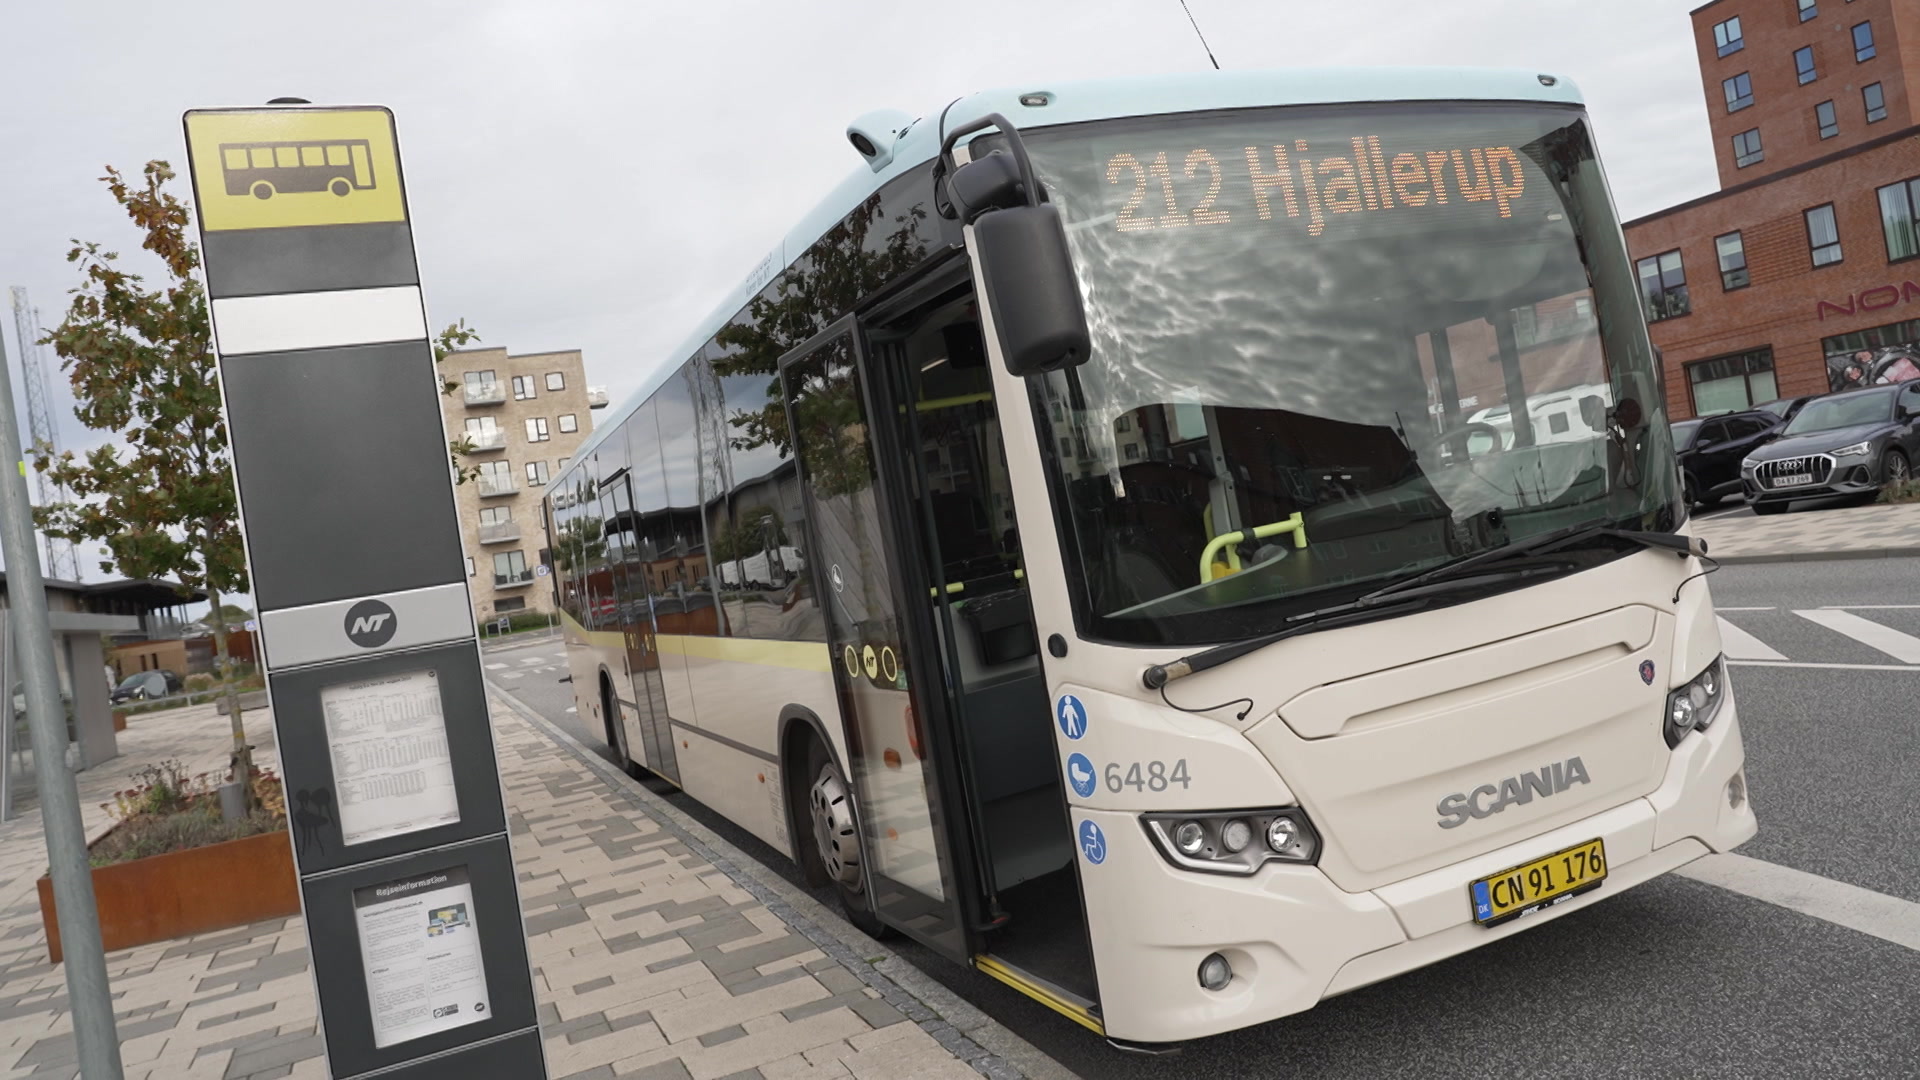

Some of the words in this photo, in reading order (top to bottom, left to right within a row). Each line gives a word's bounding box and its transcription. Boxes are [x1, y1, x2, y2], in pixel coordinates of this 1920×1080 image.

[1106, 149, 1231, 232] 212
[1245, 135, 1525, 236] Hjallerup
[351, 613, 391, 635] NT
[1104, 758, 1192, 794] 6484
[1436, 756, 1591, 829] SCANIA
[1492, 874, 1525, 908] CN
[1528, 864, 1555, 897] 91
[1562, 846, 1602, 885] 176
[1478, 903, 1489, 914] DK
